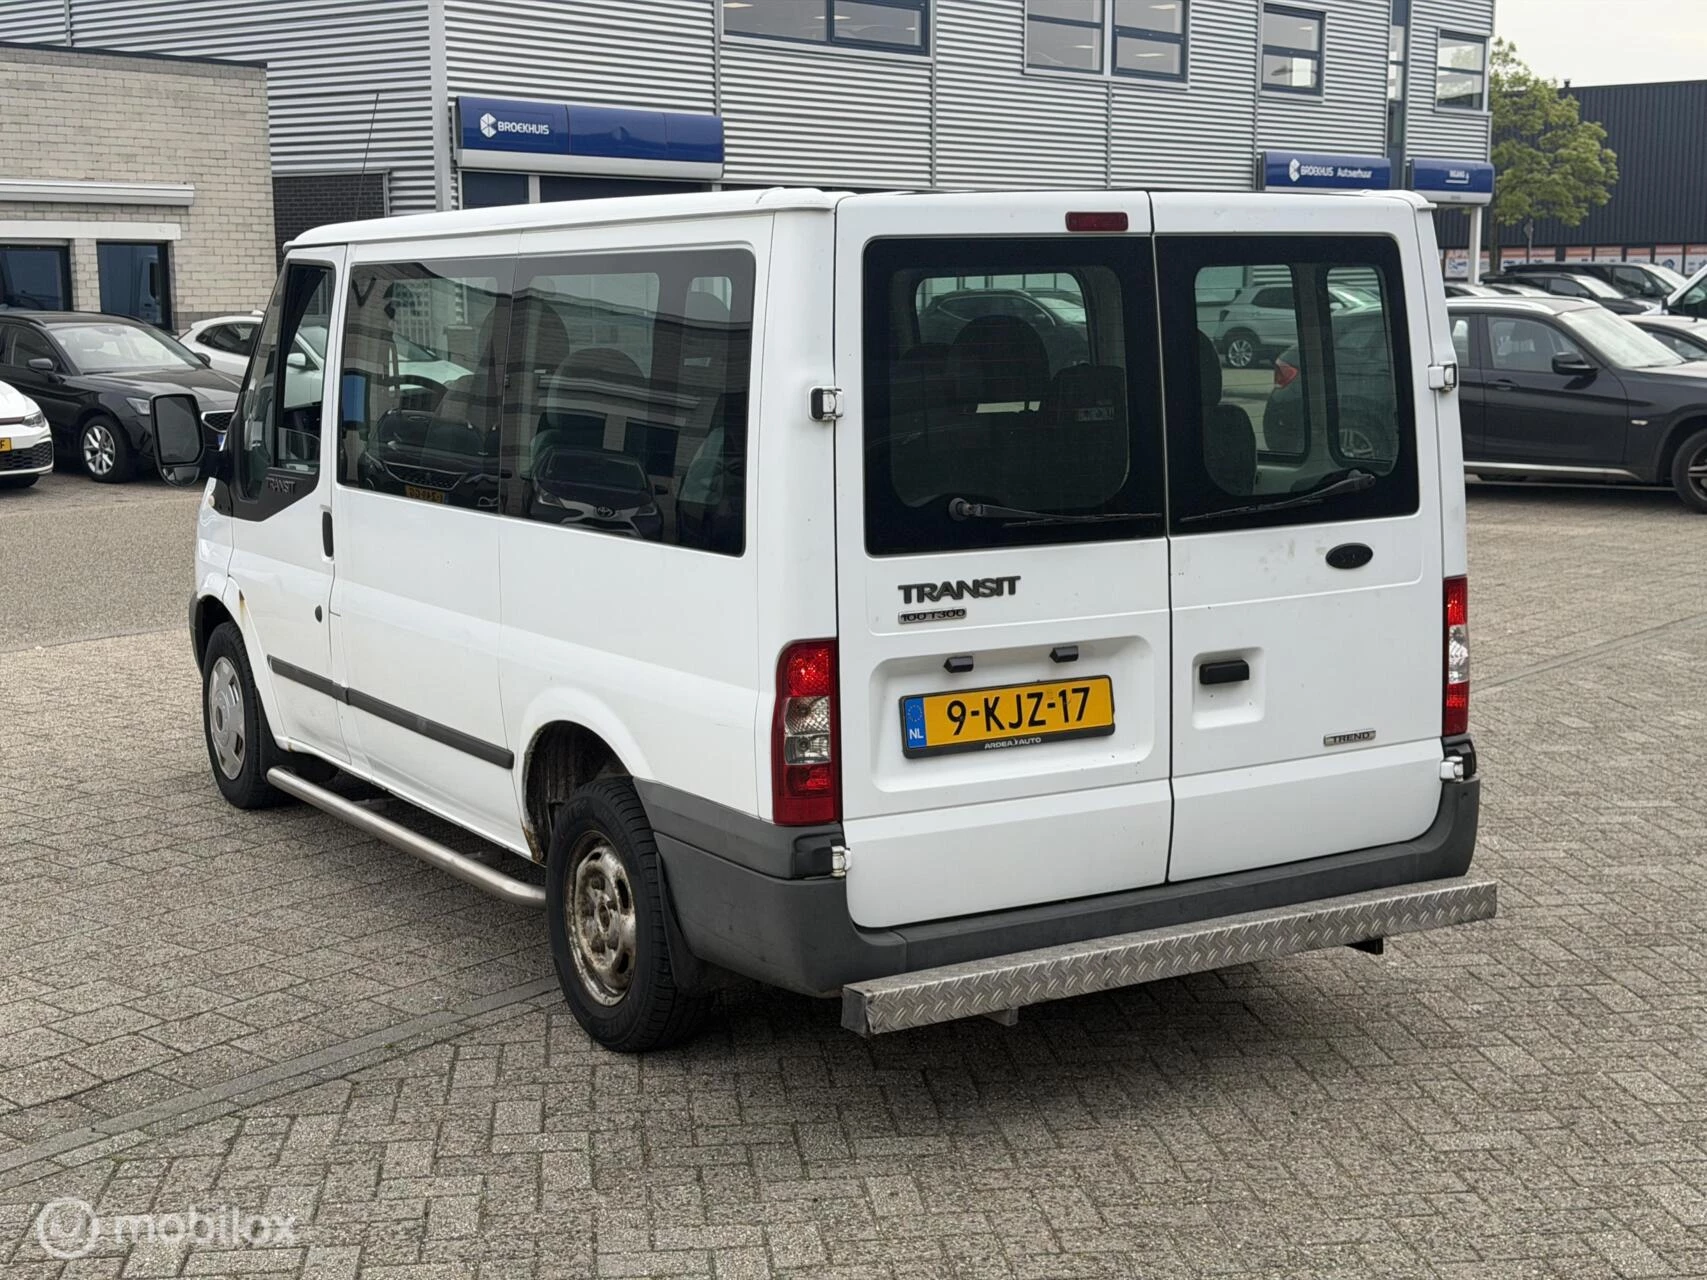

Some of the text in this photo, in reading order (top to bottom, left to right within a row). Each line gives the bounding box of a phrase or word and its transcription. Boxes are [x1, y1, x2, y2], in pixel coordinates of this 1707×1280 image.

[498, 121, 549, 135] BROEKHUIS
[1300, 164, 1334, 177] BROEKHUIS
[897, 575, 1021, 604] TRANSIT
[946, 686, 1091, 736] 9-KJZ-17
[909, 728, 924, 739] NL
[1332, 731, 1370, 743] TREND
